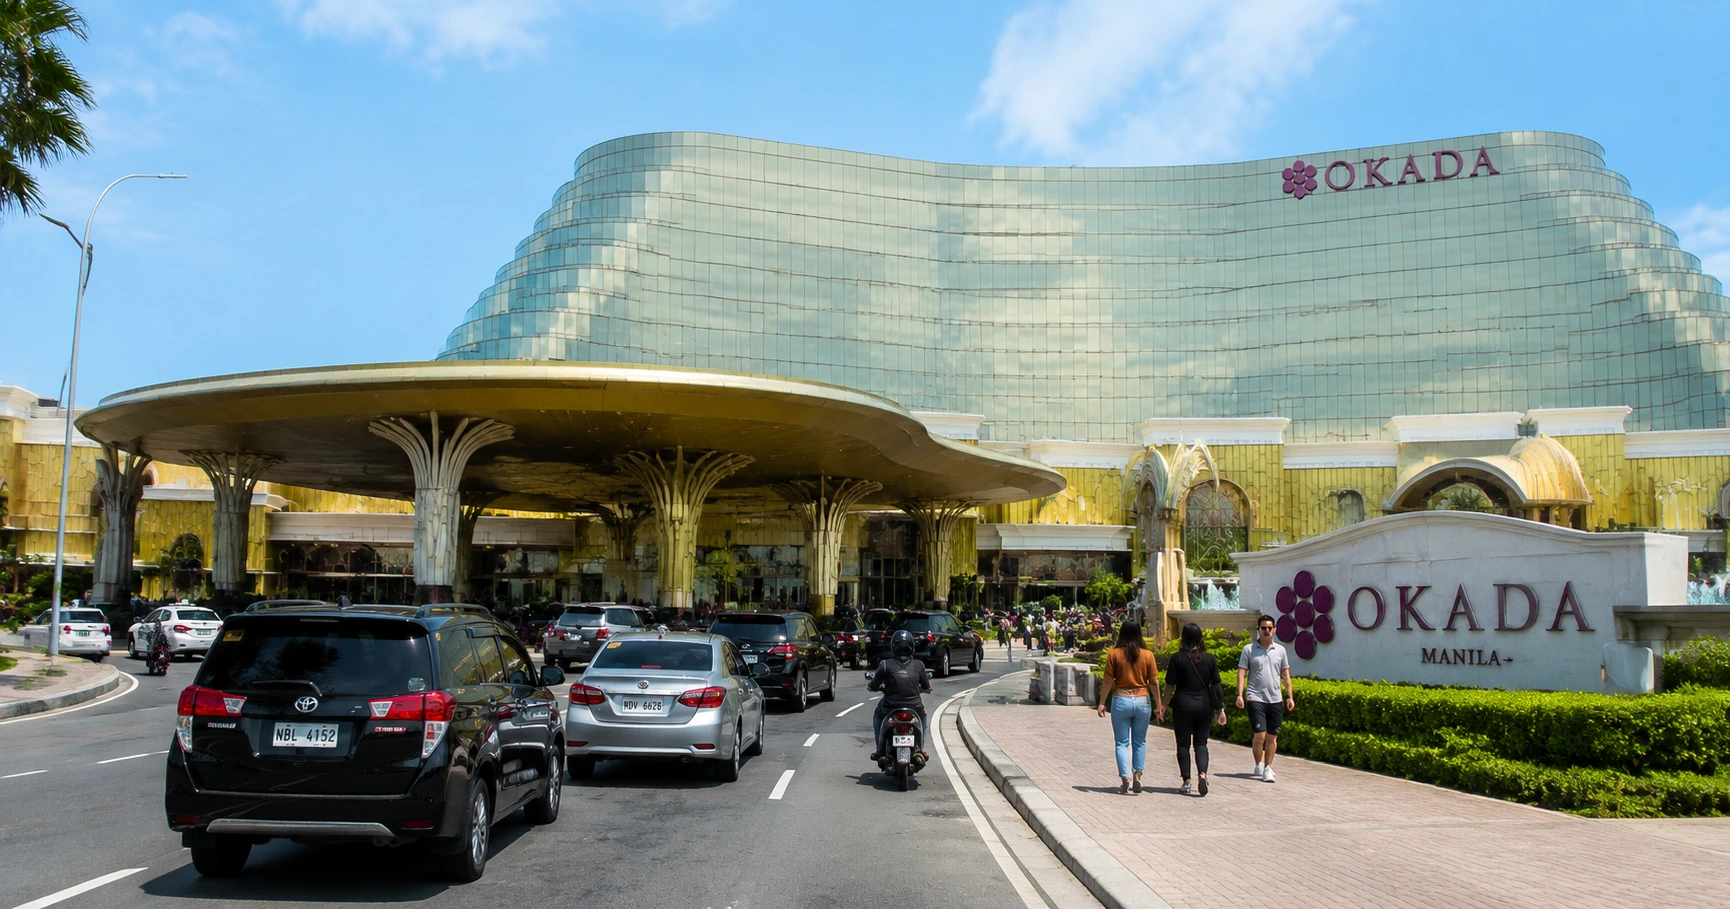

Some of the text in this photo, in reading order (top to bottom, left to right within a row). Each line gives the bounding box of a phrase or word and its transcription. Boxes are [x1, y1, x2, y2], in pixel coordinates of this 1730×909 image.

[1324, 146, 1500, 191] OKADA
[1347, 581, 1596, 632] OKADA
[1420, 647, 1502, 667] MANILA
[275, 727, 337, 743] NBL 4152
